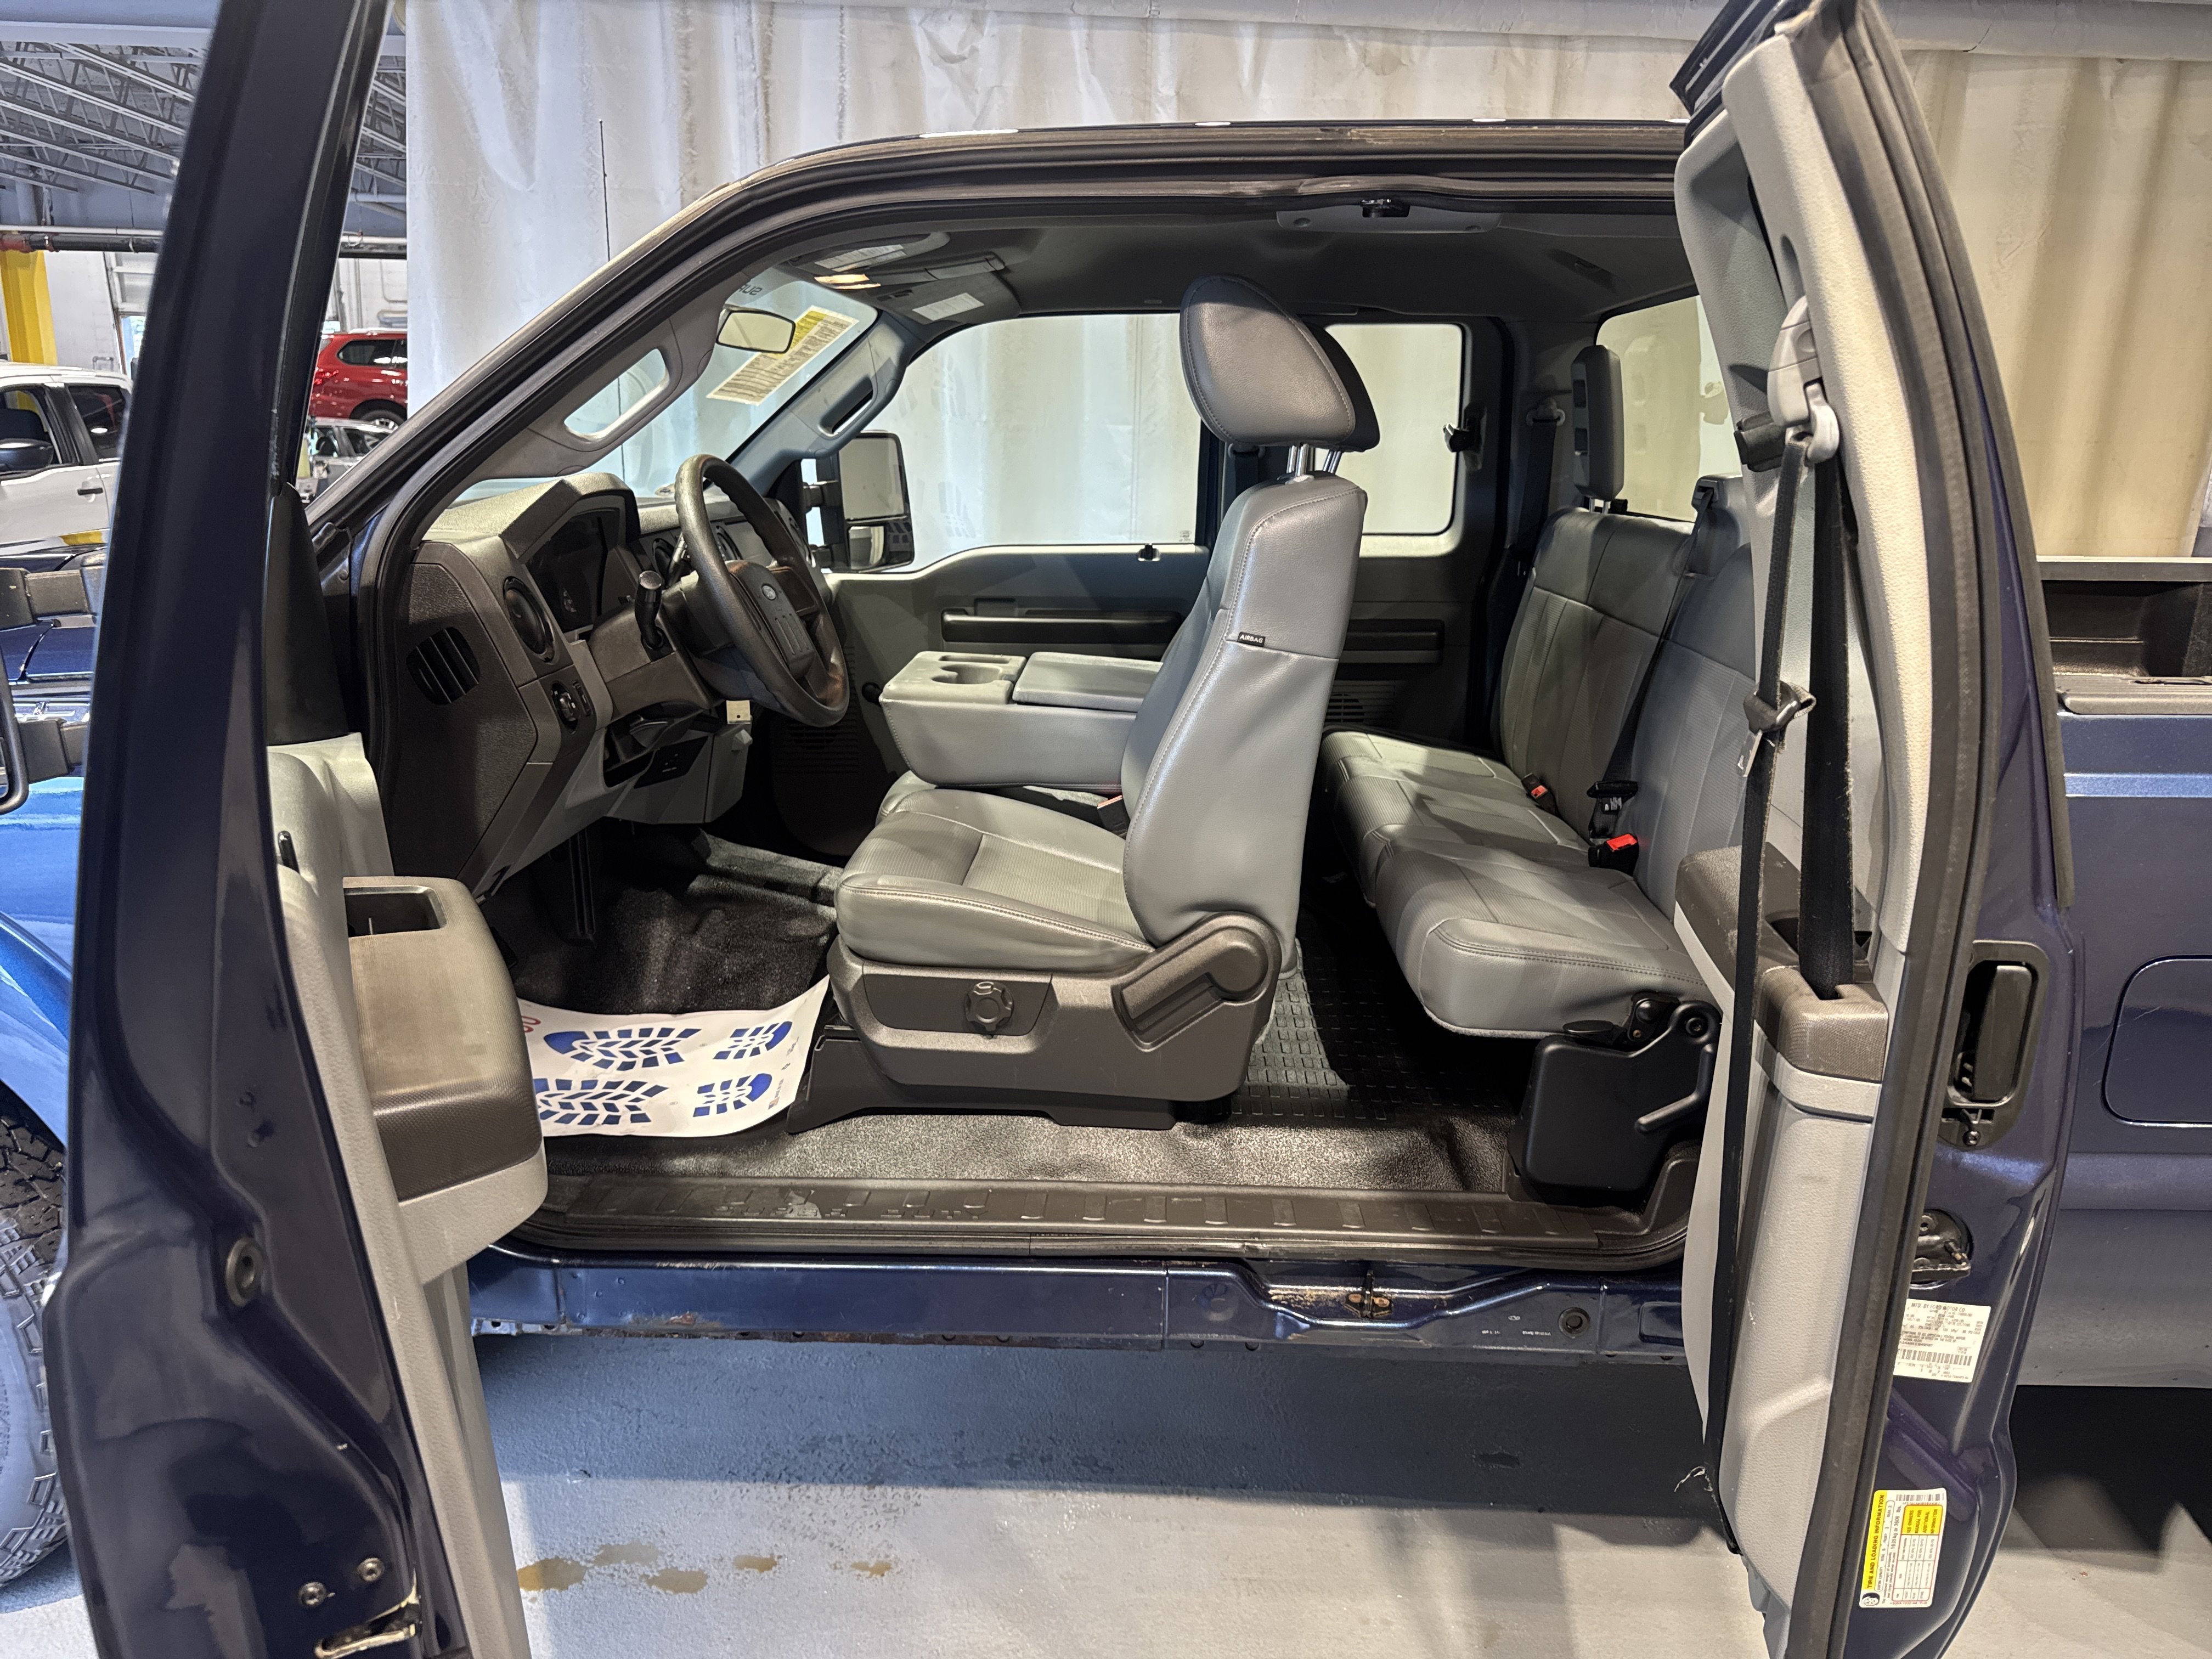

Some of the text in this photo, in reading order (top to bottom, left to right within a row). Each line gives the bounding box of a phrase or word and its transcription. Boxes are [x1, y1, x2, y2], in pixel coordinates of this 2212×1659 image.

[1239, 634, 1263, 644] AIRBAG
[1870, 1536, 1878, 1560] LOADING
[1874, 1495, 1884, 1533] INFORMATION
